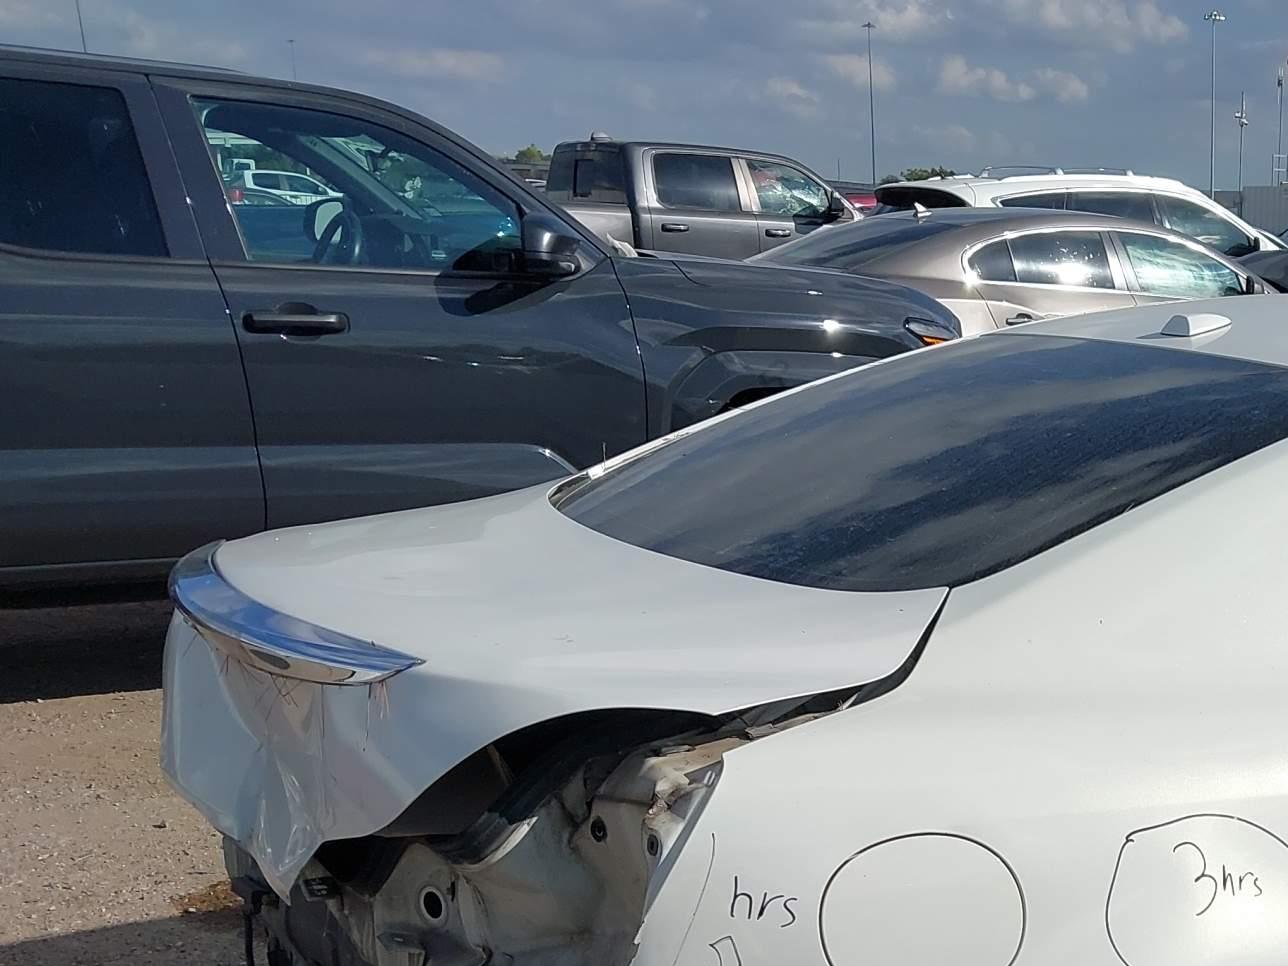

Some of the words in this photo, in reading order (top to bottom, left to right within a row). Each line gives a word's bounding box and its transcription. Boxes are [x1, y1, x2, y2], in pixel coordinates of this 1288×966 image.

[730, 876, 797, 927] hrs
[1172, 842, 1218, 917] 3
[1222, 865, 1263, 897] hrs
